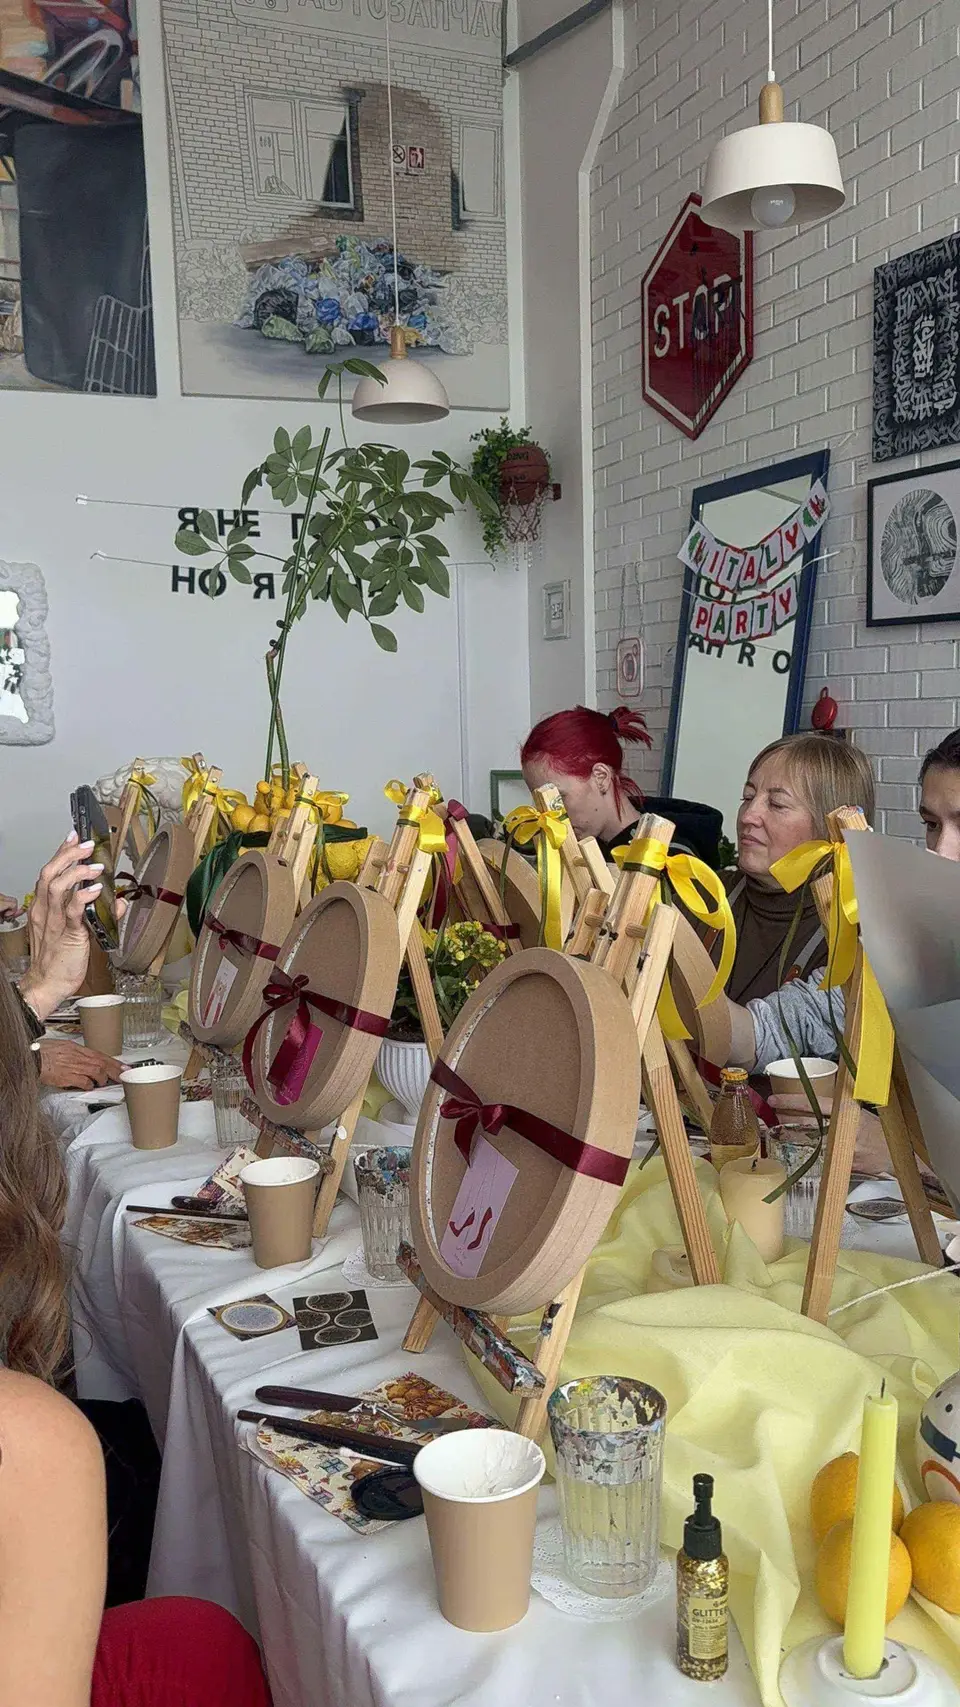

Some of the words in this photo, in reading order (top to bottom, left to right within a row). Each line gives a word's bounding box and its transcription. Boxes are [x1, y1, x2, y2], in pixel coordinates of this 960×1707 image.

[178, 508, 199, 537] Я
[709, 522, 799, 581] ITALY
[171, 565, 227, 597] НО
[695, 587, 792, 635] PARTY
